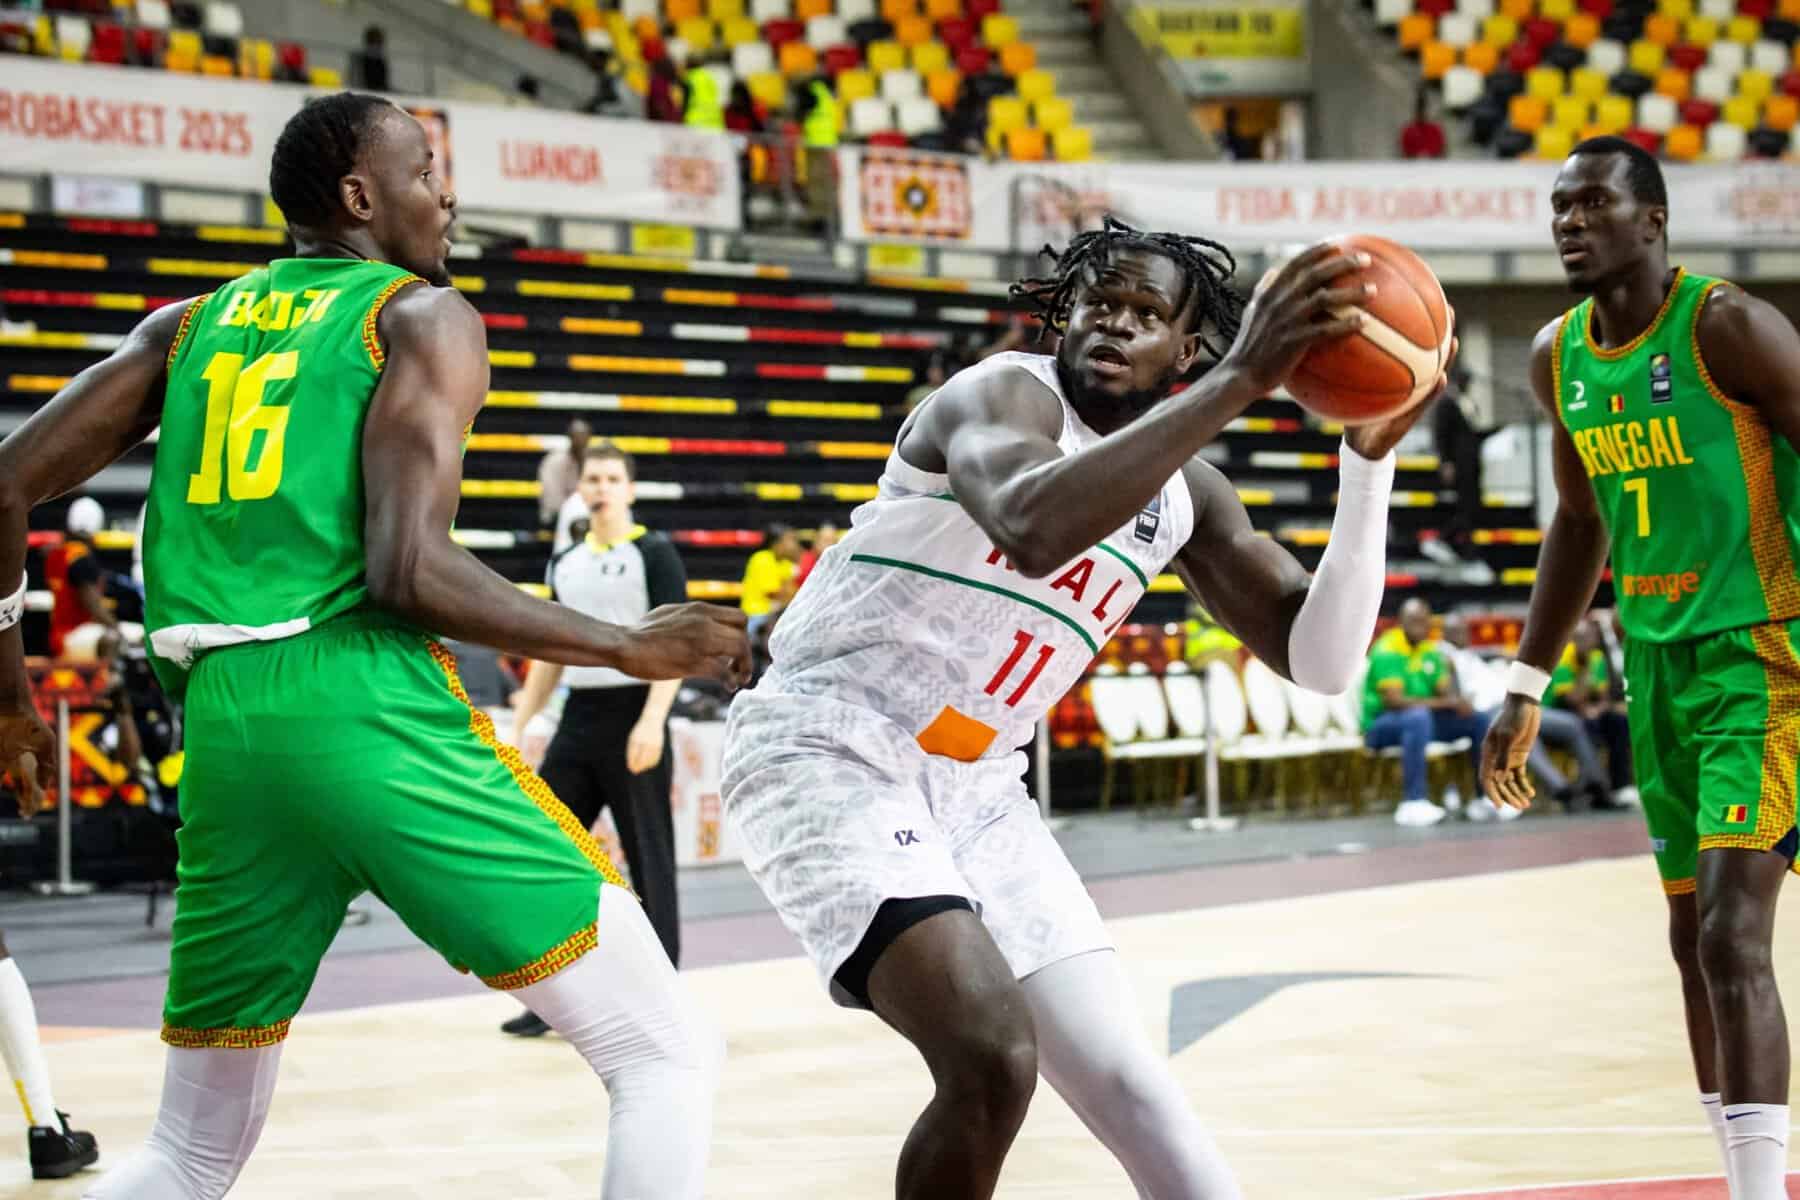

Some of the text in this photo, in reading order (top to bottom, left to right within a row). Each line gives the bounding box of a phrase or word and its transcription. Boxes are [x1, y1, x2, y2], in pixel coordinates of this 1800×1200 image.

[178, 105, 254, 156] 2025
[498, 140, 603, 184] LUANDA
[1216, 185, 1537, 223] FIBA AFROBASKET
[217, 288, 342, 331] BADJI
[187, 351, 299, 504] 16
[1573, 415, 1694, 478] SENEGAL
[1623, 477, 1650, 537] 7
[983, 629, 1056, 708] 11
